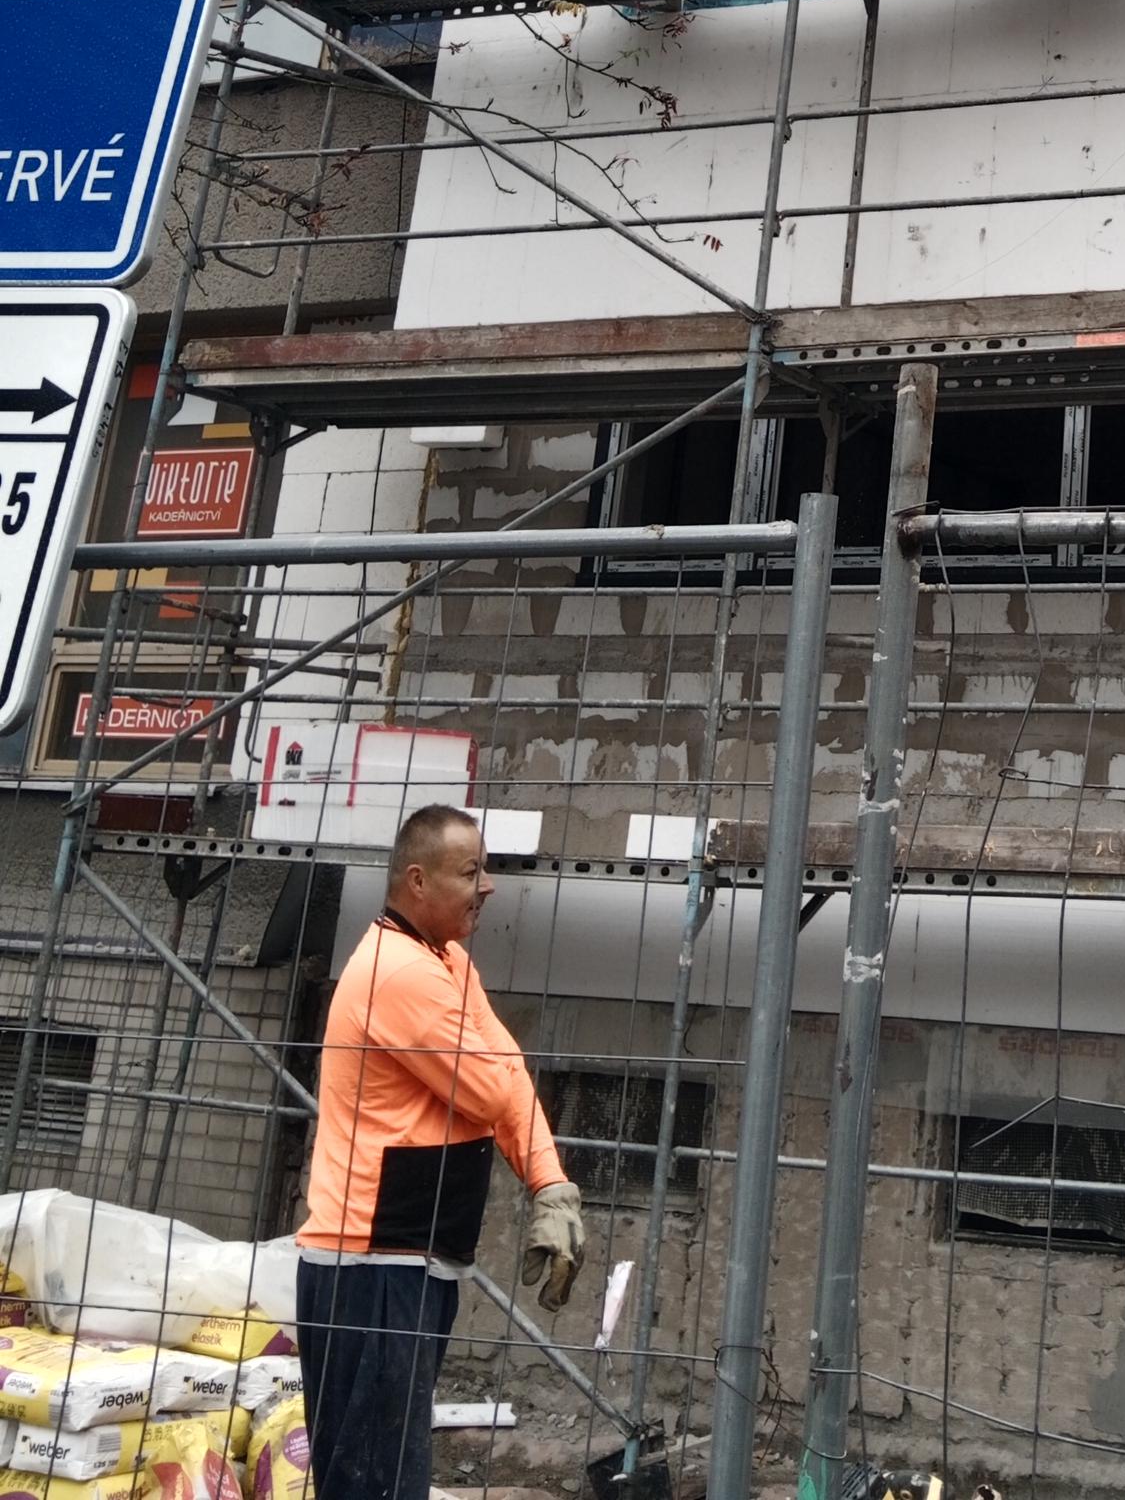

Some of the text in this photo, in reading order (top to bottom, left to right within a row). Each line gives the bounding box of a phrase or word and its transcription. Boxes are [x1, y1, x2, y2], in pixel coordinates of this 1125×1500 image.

[0, 472, 37, 536] 5
[148, 506, 222, 522] KADEŘNICTVÍ
[82, 703, 213, 728] DEŘNICT
[192, 1379, 228, 1394] weber
[281, 1378, 304, 1392] web
[98, 1391, 144, 1410] weber
[29, 1441, 71, 1460] weber
